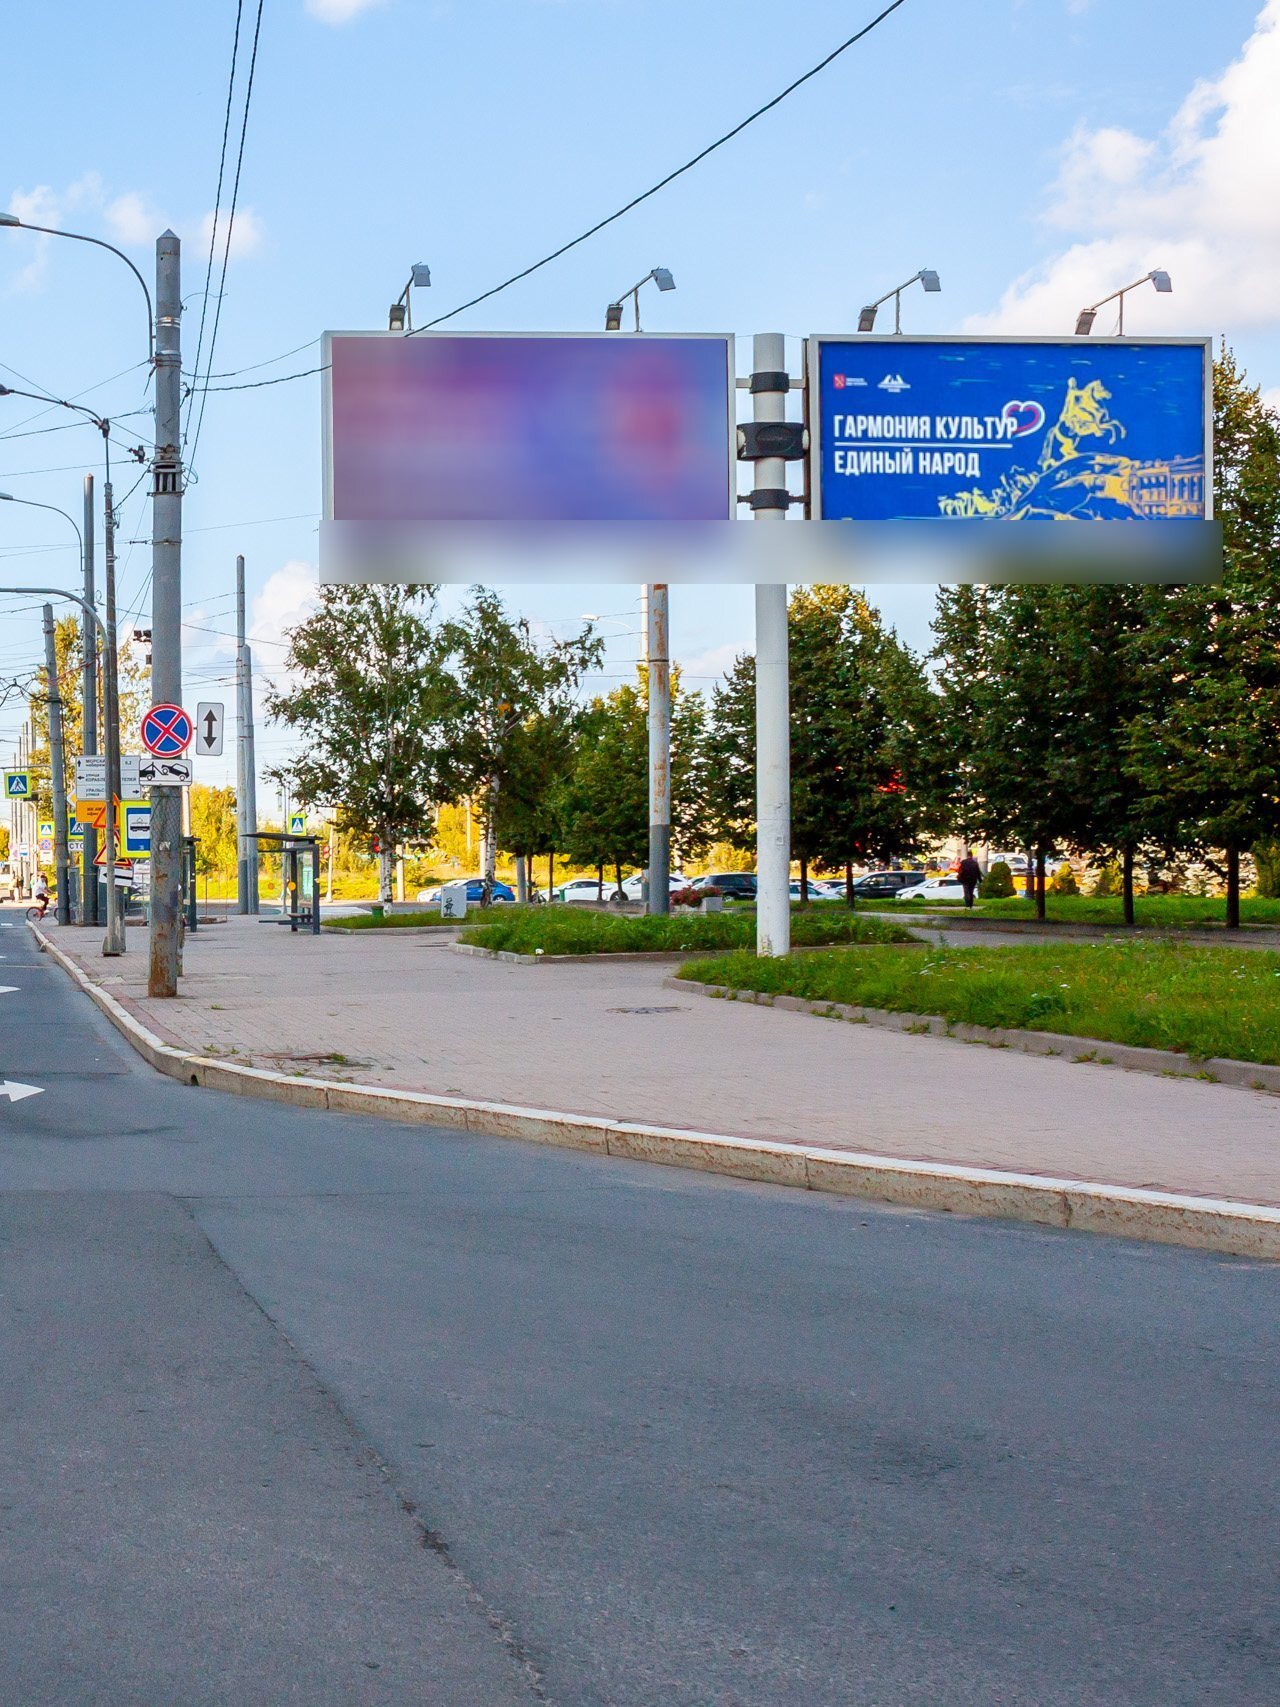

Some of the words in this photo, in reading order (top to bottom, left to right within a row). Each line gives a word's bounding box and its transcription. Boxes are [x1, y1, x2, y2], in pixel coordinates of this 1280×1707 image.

[833, 415, 930, 438] ГАРМОНИЯ
[935, 416, 1018, 439] КУЛЬТУР
[834, 447, 914, 476] ЕДИНЫЙ
[918, 452, 981, 478] НАРОД
